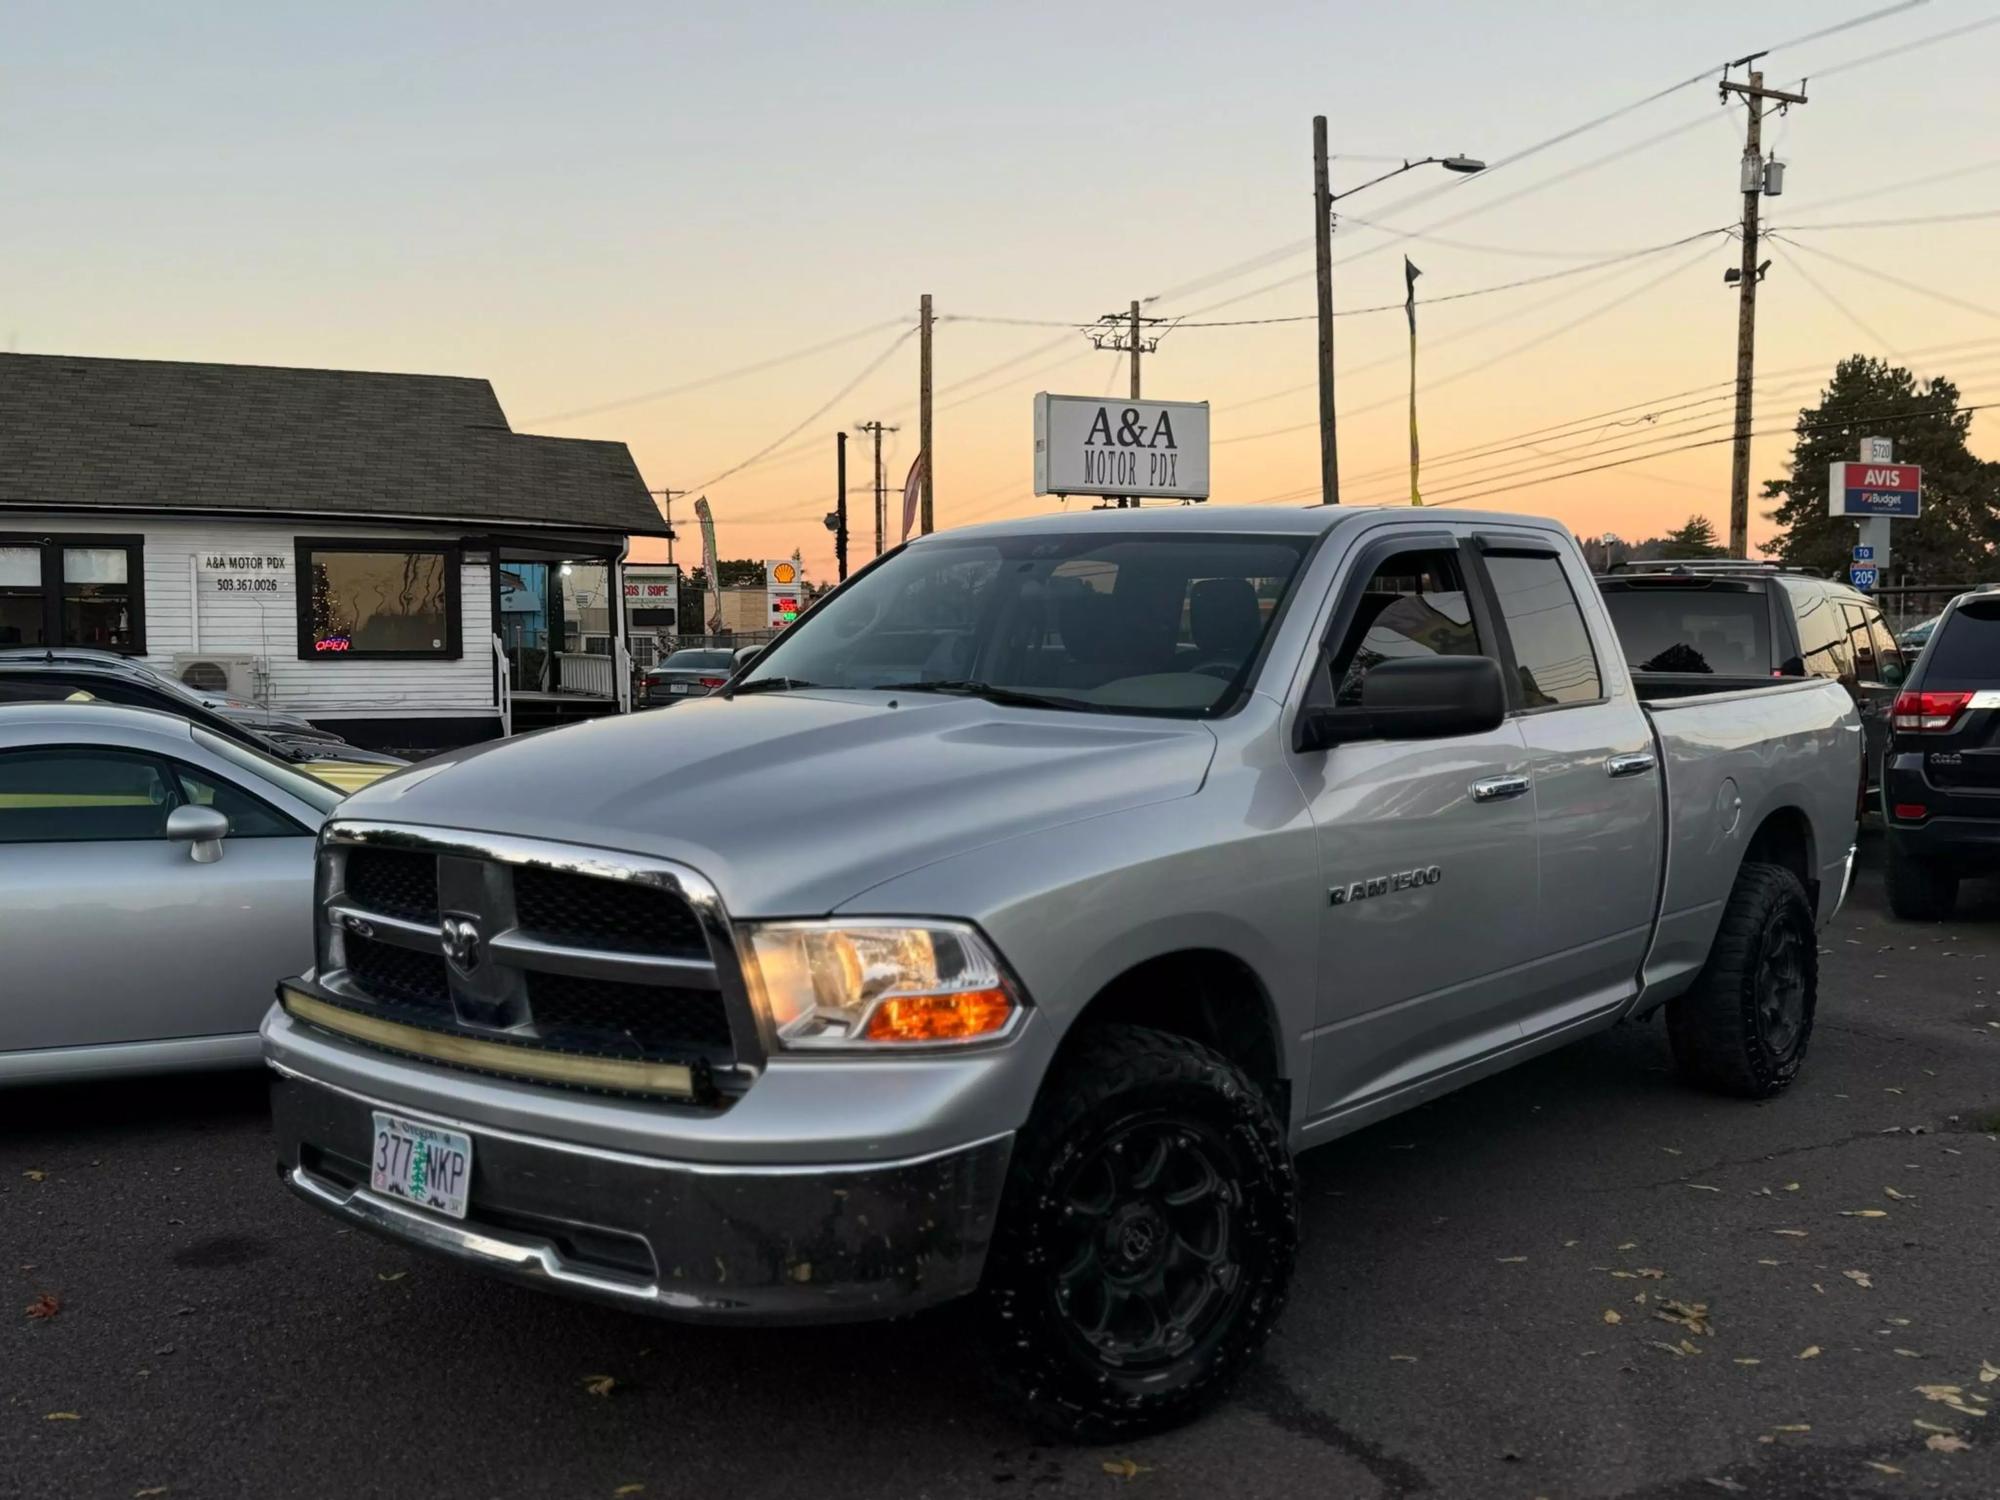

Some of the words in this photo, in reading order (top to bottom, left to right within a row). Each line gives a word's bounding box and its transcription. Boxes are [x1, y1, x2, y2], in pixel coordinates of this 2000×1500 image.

[1084, 407, 1178, 450] A&A
[1084, 449, 1137, 486] MOTOR
[1149, 452, 1178, 487] PDX
[1863, 468, 1901, 488] AVIS
[1872, 493, 1902, 507] Budget
[1859, 548, 1870, 558] TO
[206, 556, 226, 569] A&A
[228, 556, 264, 569] MOTOR
[266, 556, 286, 569] PDX
[217, 578, 278, 592] 503.367.0026
[1855, 570, 1874, 585] 205
[315, 640, 349, 651] OPEN
[1328, 876, 1388, 907] RAM
[1390, 864, 1442, 892] 1500
[376, 1131, 414, 1180] 377
[424, 1144, 465, 1194] NKP
